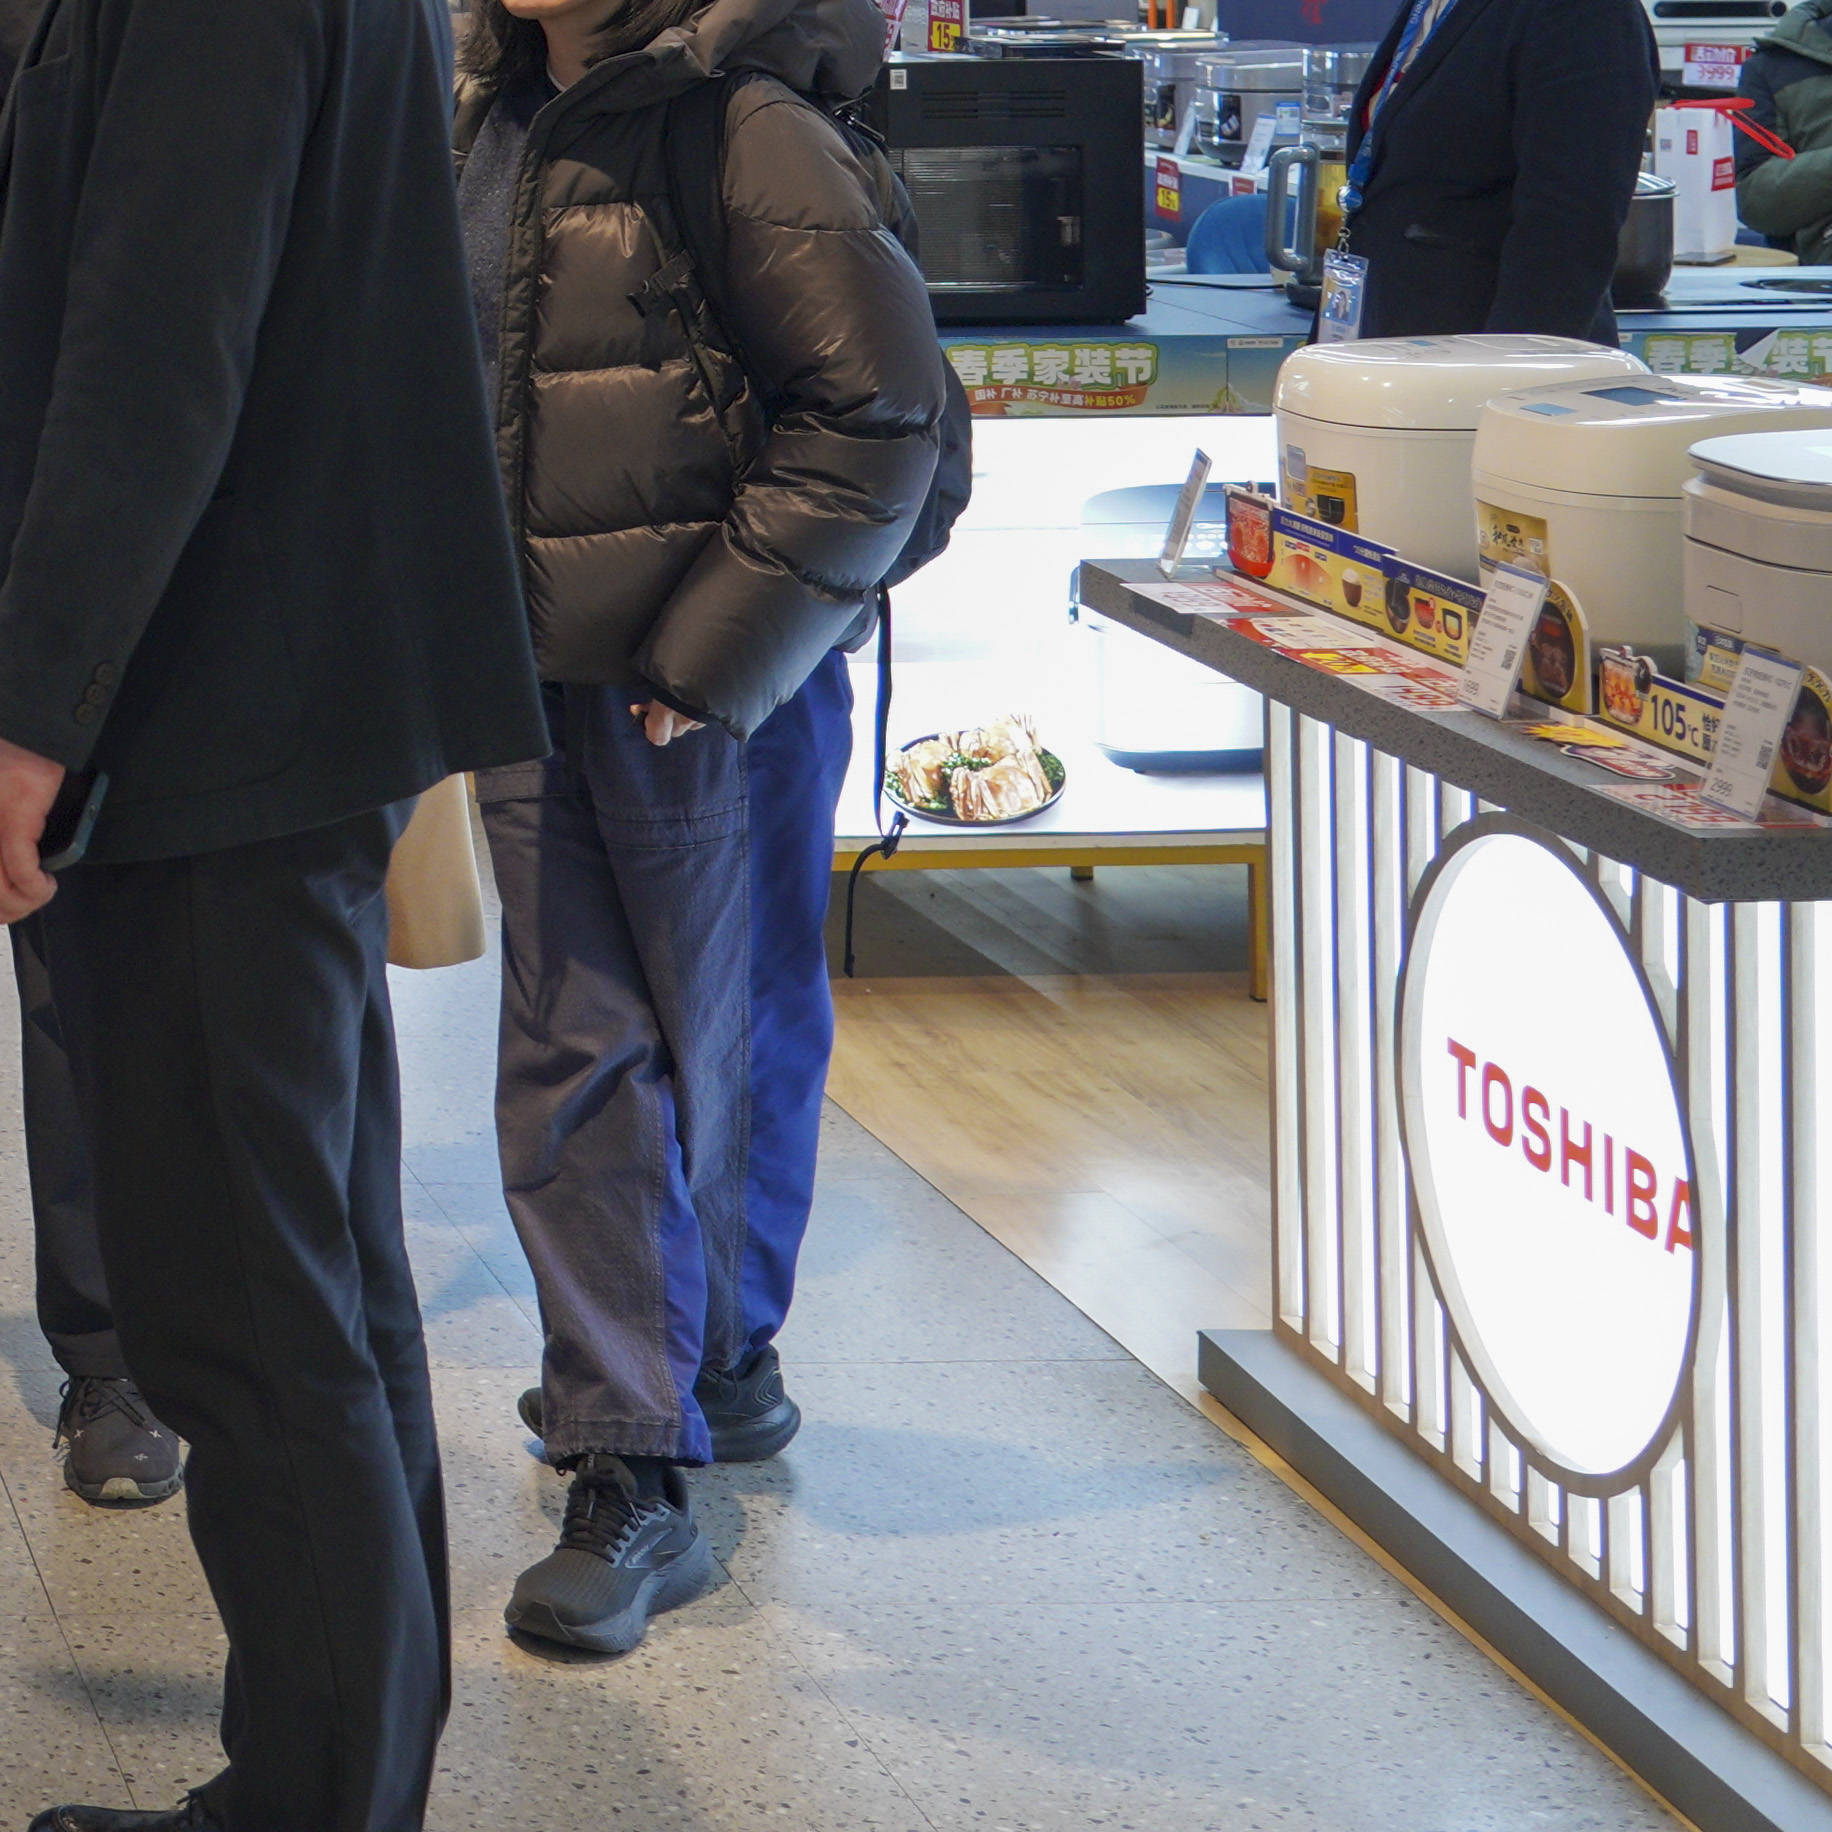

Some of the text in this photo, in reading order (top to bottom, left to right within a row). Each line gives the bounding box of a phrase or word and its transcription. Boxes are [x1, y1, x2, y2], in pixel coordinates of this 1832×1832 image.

[950, 346, 1154, 386] 春季家装节
